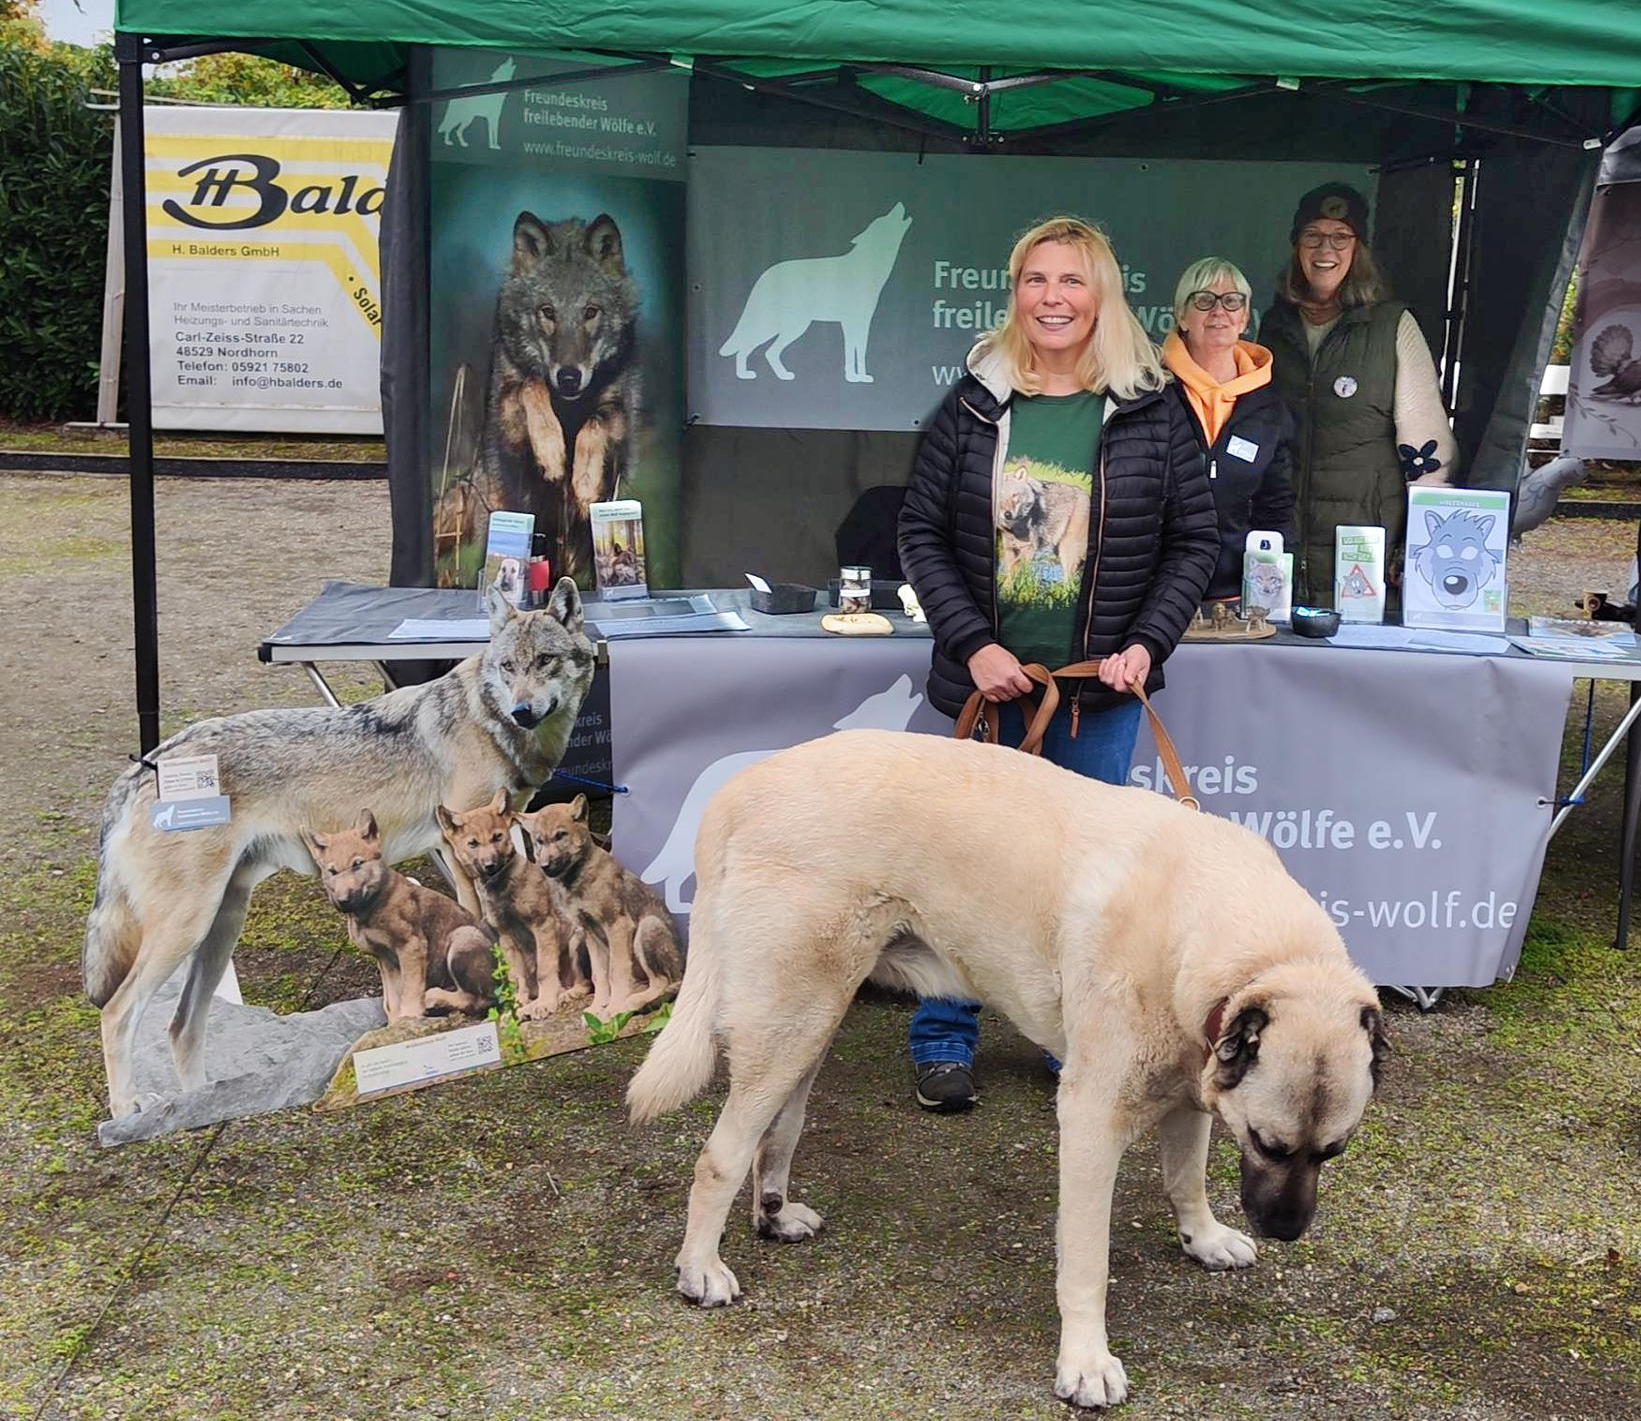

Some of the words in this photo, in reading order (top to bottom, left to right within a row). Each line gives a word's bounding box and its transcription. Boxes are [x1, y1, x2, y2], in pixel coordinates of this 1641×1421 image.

[524, 88, 609, 111] Freundeskreis
[524, 108, 598, 129] freilebender
[601, 116, 634, 134] Wölfe
[172, 244, 186, 255] H.
[189, 244, 238, 256] Balders
[241, 245, 280, 257] GmbH
[173, 302, 188, 312] Ihr
[190, 302, 266, 314] Meisterbetrieb
[269, 304, 279, 314] in
[281, 304, 322, 314] Sachen
[174, 315, 227, 327] Heizungs-
[231, 316, 250, 326] und
[175, 331, 286, 344] Carl-Zeiss-Straße
[289, 334, 305, 345] 22
[176, 346, 214, 357] 48529
[217, 347, 278, 358] Nordhorn
[177, 360, 228, 372] Telefon:
[231, 361, 268, 372] 05921
[273, 362, 309, 374] 75802
[177, 375, 217, 387] Email:
[232, 375, 343, 390] info@hbalders.de
[1130, 755, 1258, 795] skreis
[1367, 810, 1442, 850] e.V.
[1319, 889, 1518, 930] is-wolf.de
